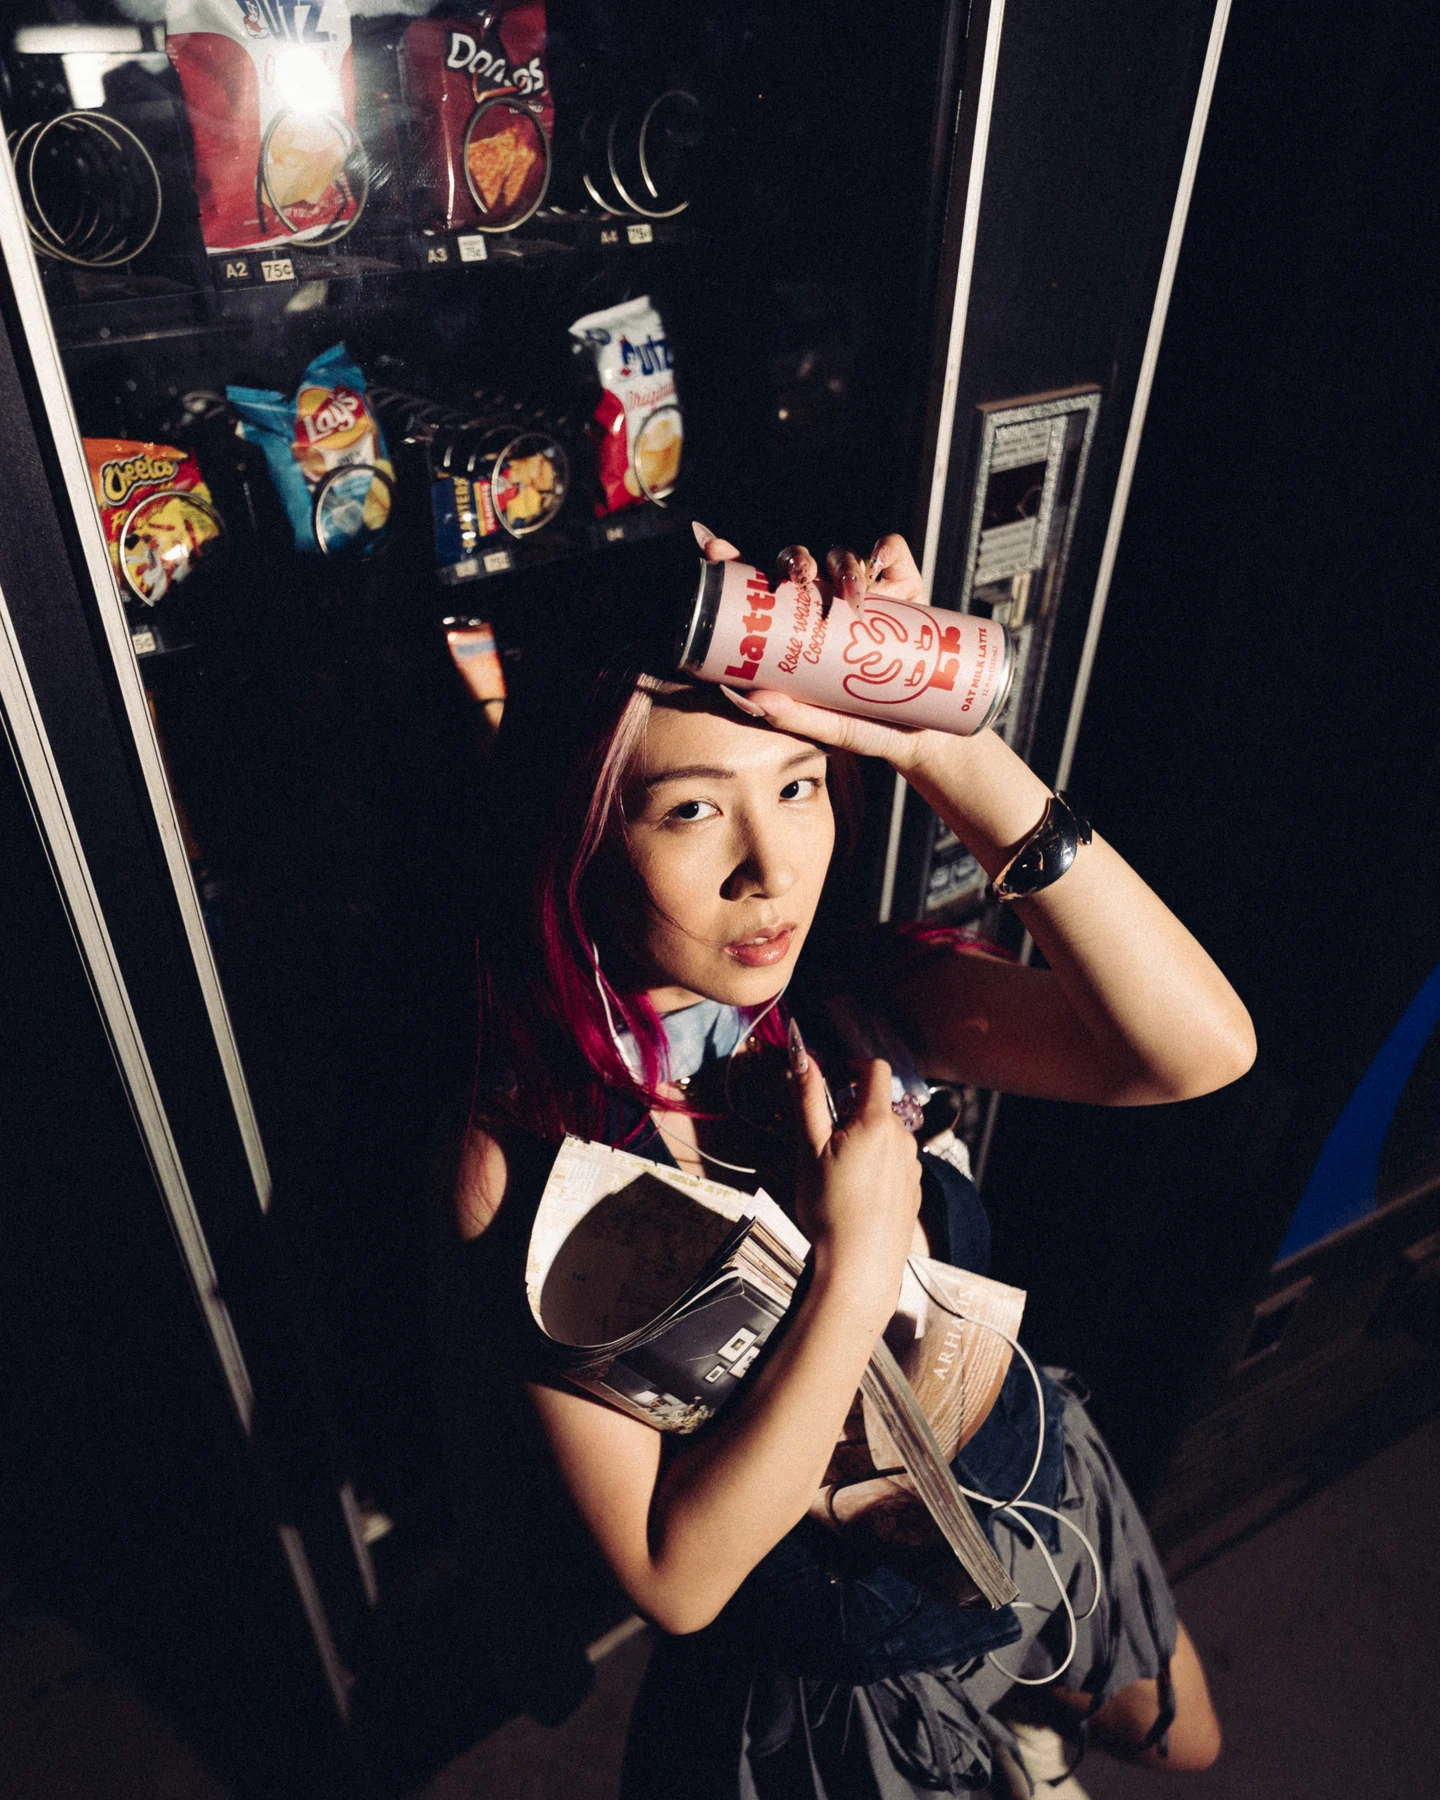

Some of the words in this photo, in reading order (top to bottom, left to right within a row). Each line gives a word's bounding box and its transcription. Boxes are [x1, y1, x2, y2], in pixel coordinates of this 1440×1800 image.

[226, 261, 248, 278] A2
[427, 247, 448, 264] A3
[102, 455, 177, 503] Cheetos
[777, 637, 803, 675] Rose
[978, 627, 988, 658] LATTE
[971, 661, 986, 689] MILK
[961, 689, 976, 712] OAT
